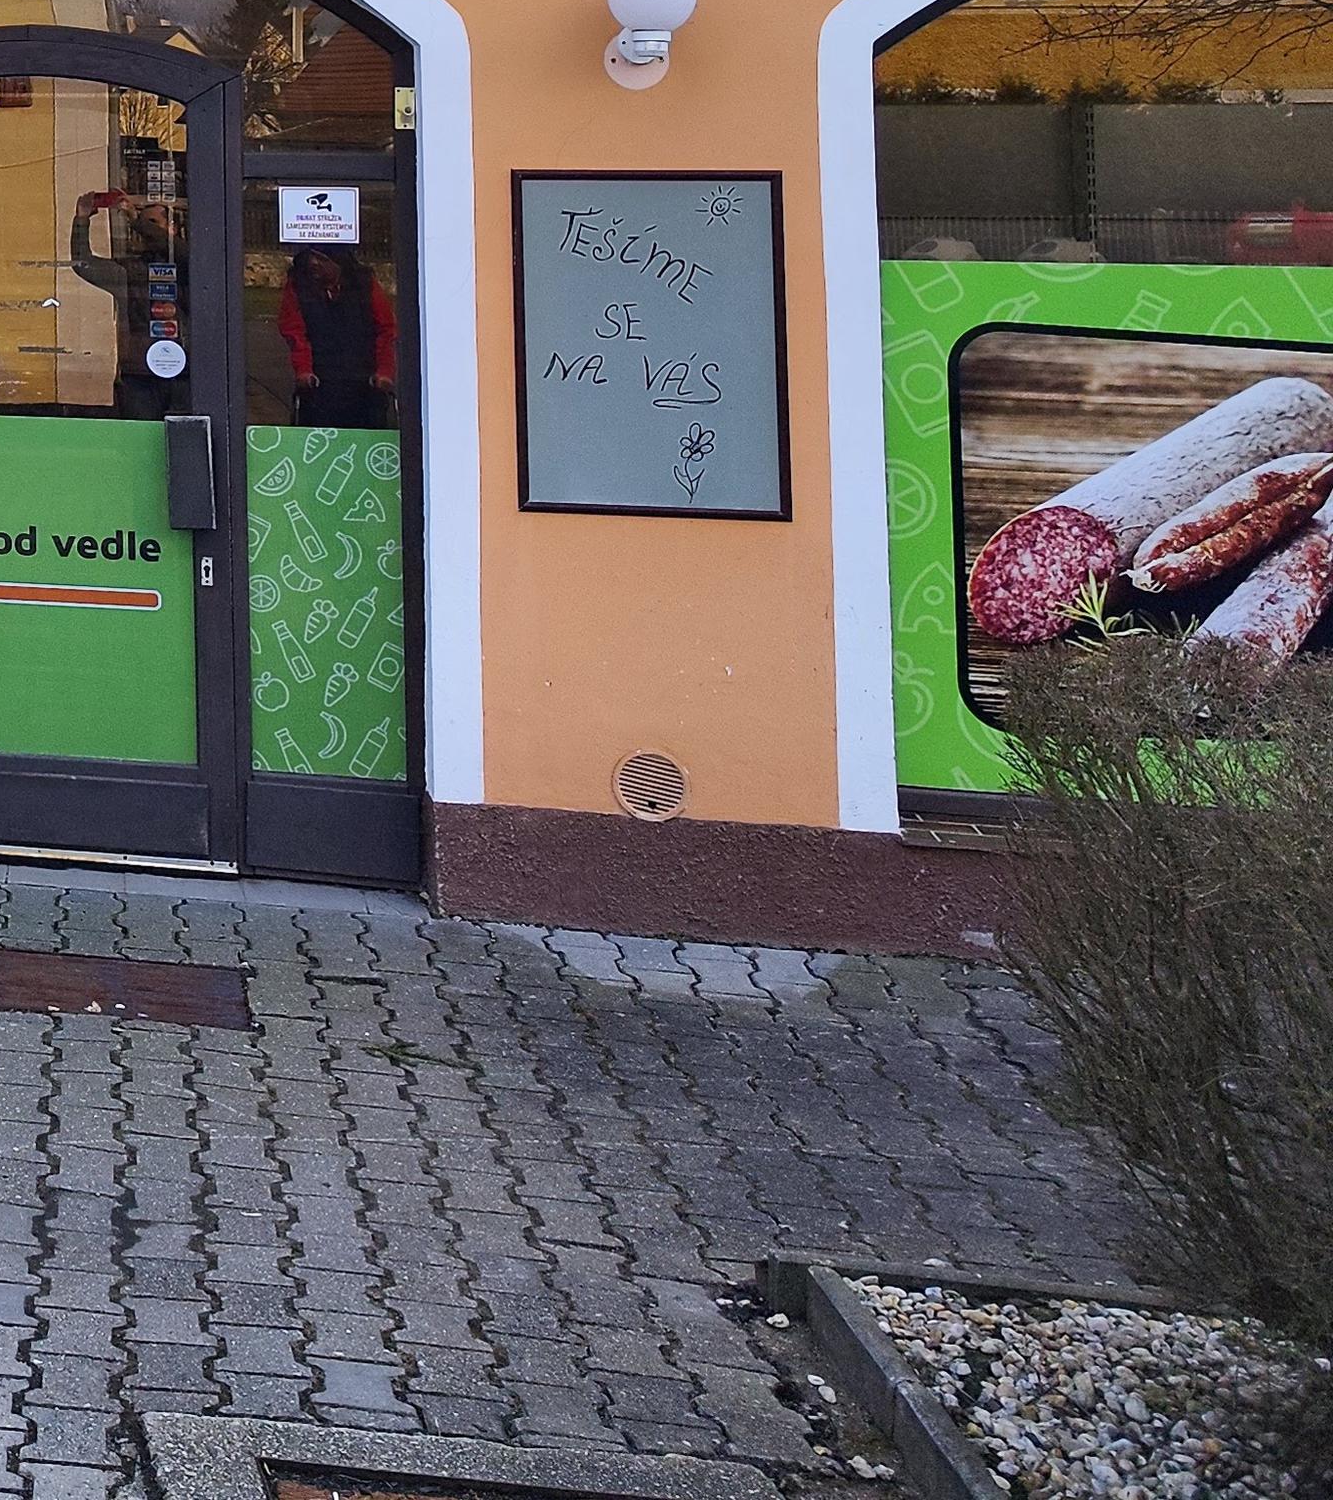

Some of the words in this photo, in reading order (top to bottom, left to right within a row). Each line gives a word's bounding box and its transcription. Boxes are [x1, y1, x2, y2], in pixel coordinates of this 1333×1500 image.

[153, 267, 174, 277] VISA
[595, 303, 647, 340] SE
[543, 352, 608, 385] NA
[642, 352, 722, 405] VÁS
[51, 529, 162, 562] vedle
